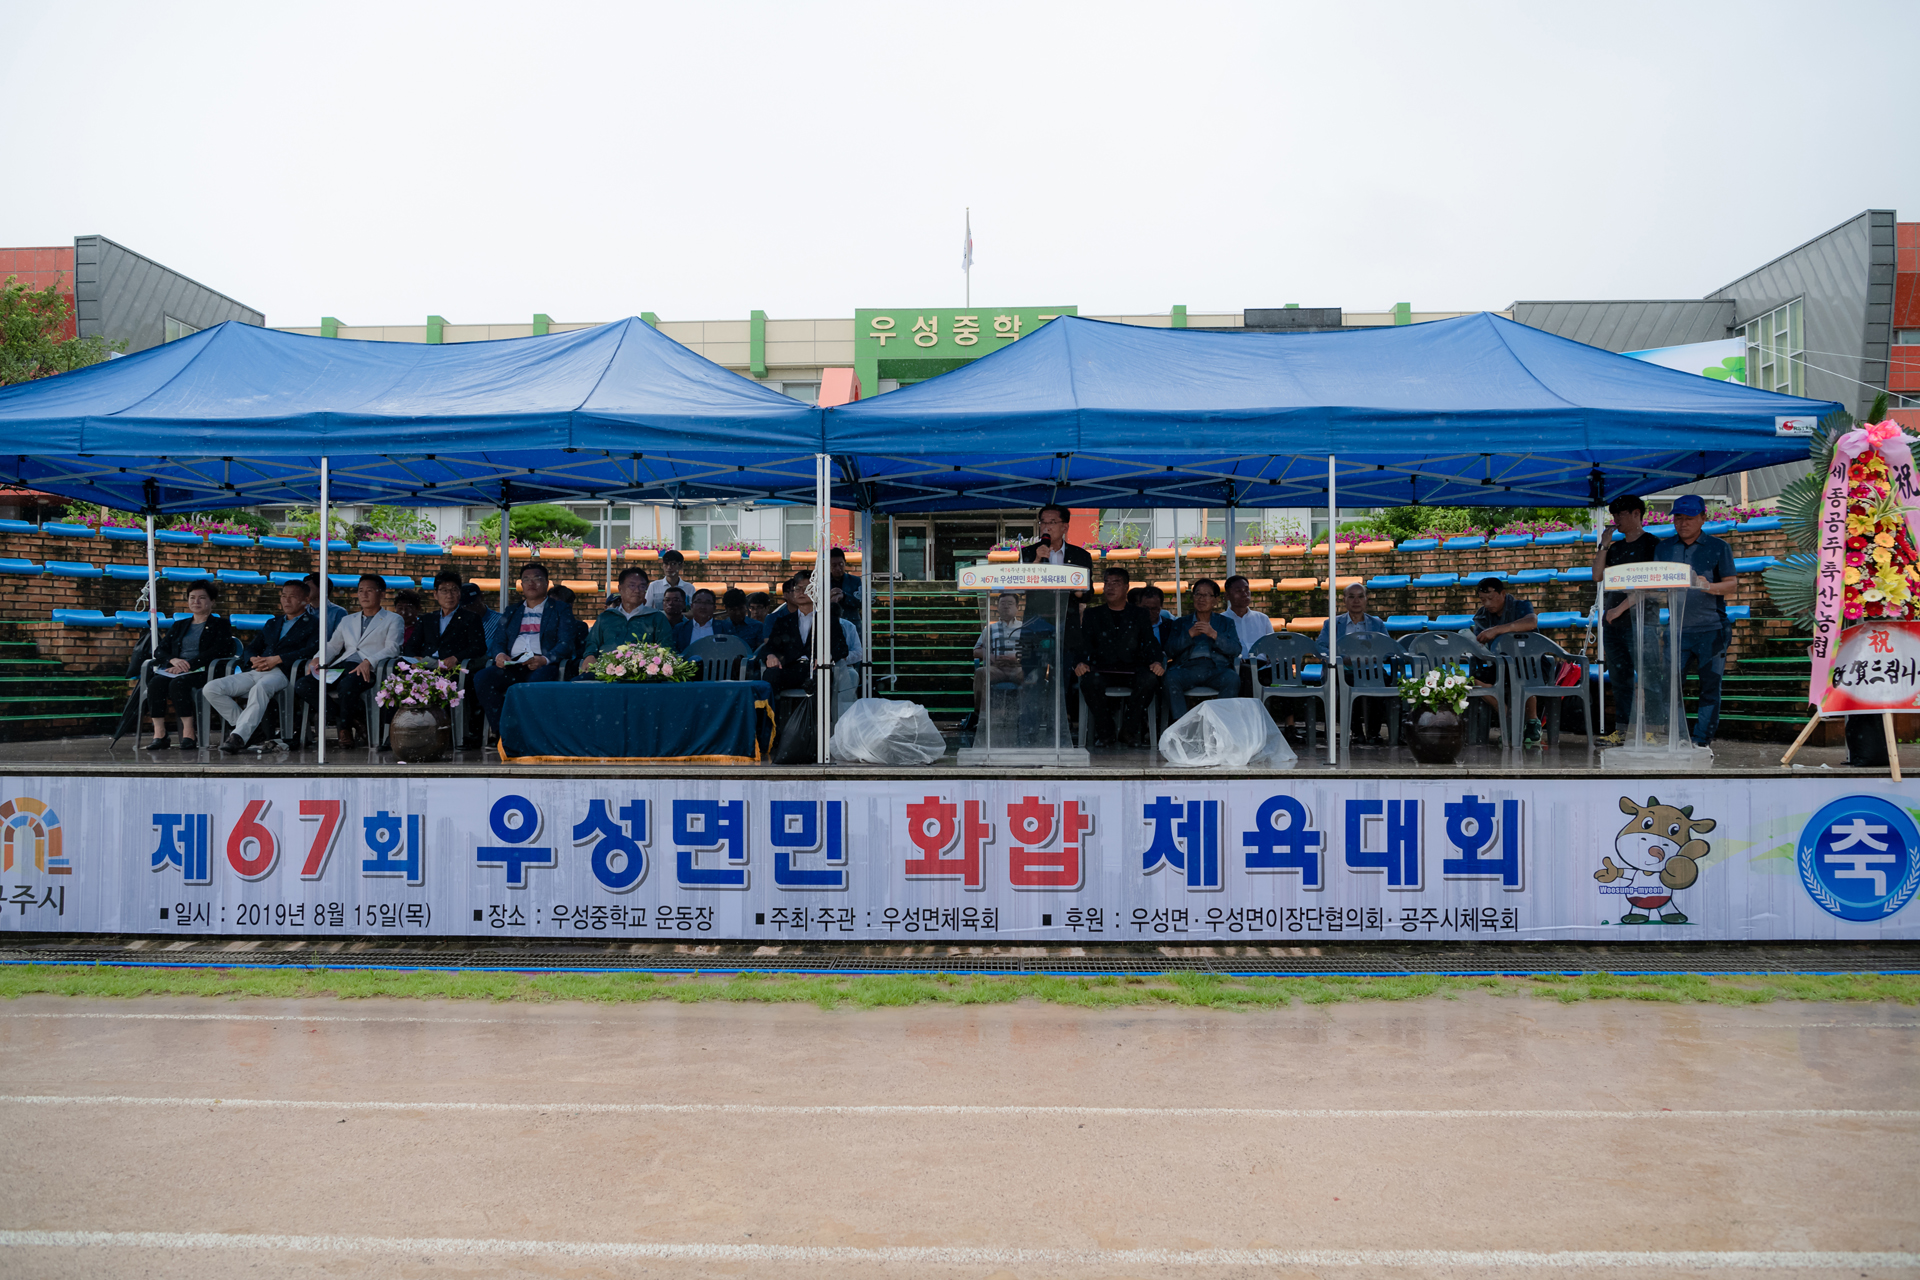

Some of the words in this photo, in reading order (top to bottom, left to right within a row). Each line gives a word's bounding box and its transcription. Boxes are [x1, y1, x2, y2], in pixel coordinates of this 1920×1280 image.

[869, 314, 1060, 348] 우성중학
[1000, 575, 1026, 584] 우성면민
[1026, 575, 1040, 584] 화합
[1041, 575, 1067, 584] 체육대회
[151, 799, 425, 886] 제67회
[476, 794, 850, 893] 우성면민
[905, 795, 1095, 892] 화합
[1142, 794, 1524, 892] 체육대회
[1824, 818, 1896, 896] 축
[0, 885, 65, 916] 주시
[175, 902, 211, 926] 일시
[236, 902, 305, 927] 2019년
[314, 902, 345, 927] 8월
[355, 903, 431, 928] 15일(목)
[488, 904, 526, 928] 장소
[551, 905, 647, 930] 우성중학교
[655, 905, 714, 931] 운동장
[881, 907, 999, 932] 우성면체육회
[1065, 907, 1104, 932] 후원
